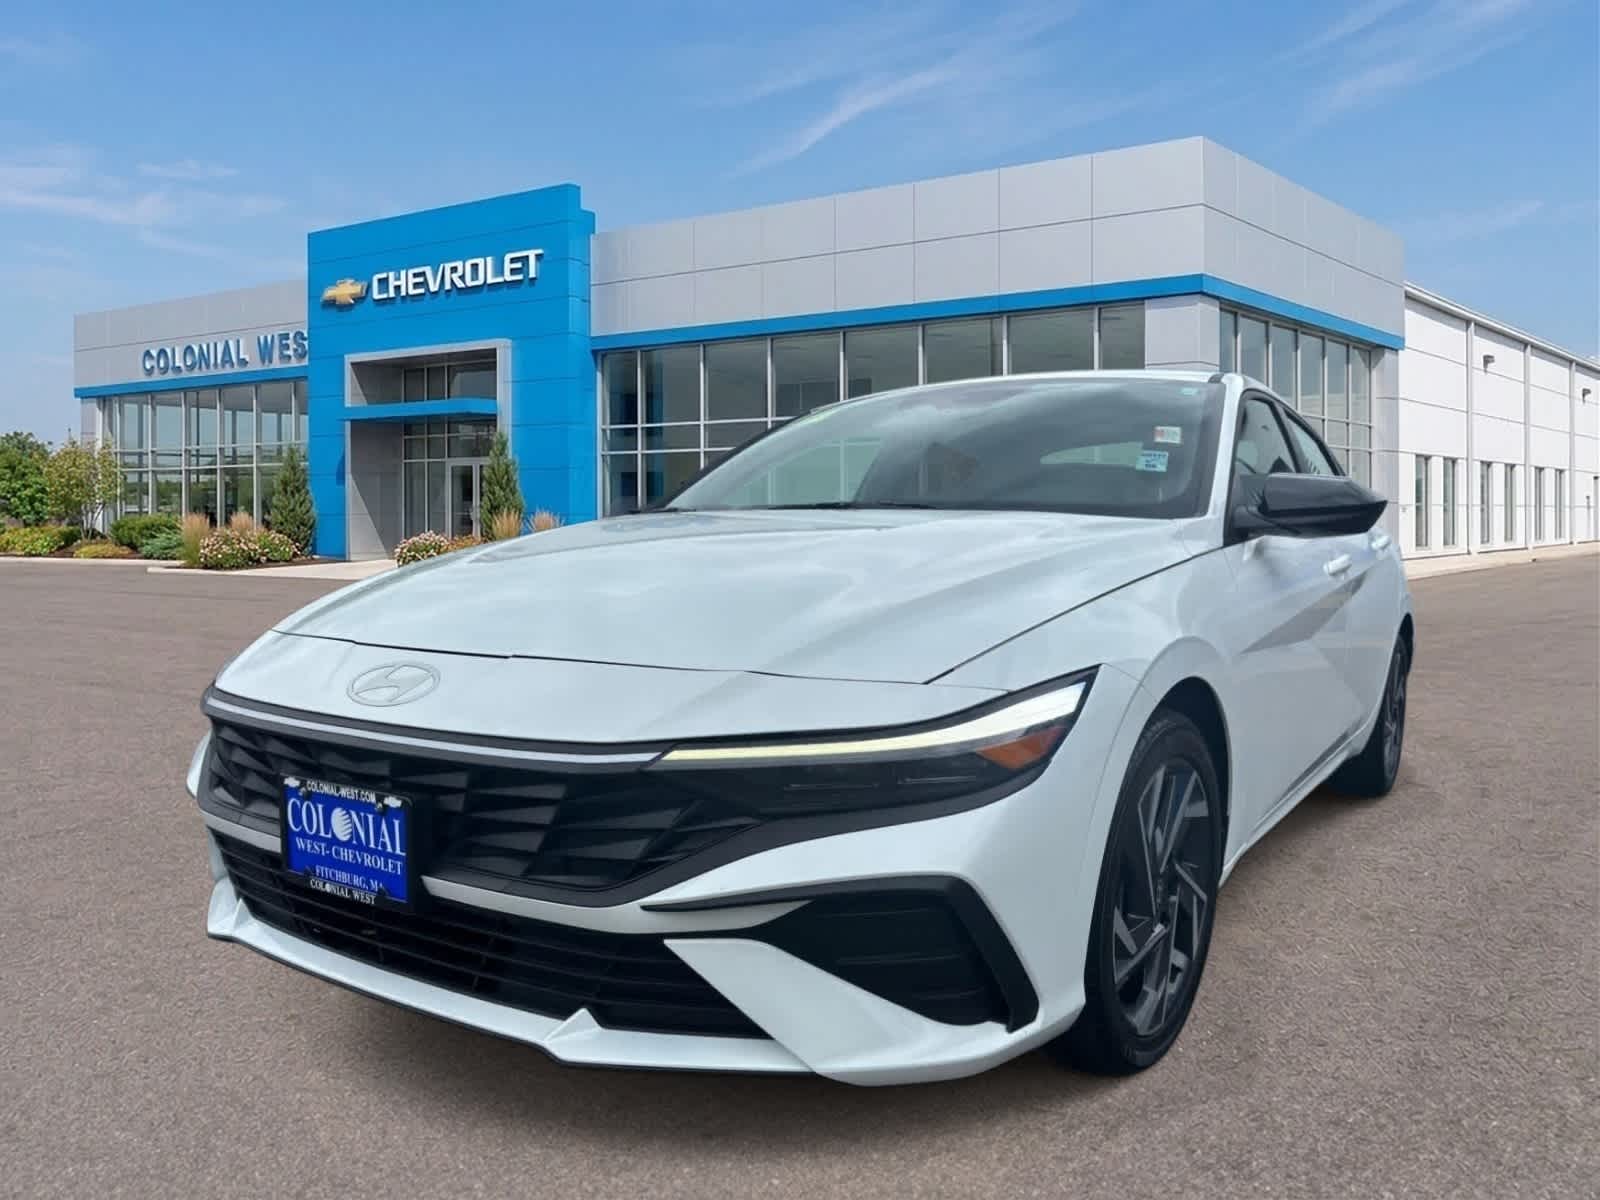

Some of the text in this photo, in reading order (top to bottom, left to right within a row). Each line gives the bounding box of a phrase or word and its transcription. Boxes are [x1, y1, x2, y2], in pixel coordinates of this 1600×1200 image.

[371, 248, 544, 300] CHEVROLET
[142, 330, 308, 376] COLONIAL WES
[287, 798, 406, 856] COLONIAL
[310, 879, 376, 905] COLONIAL WEST
